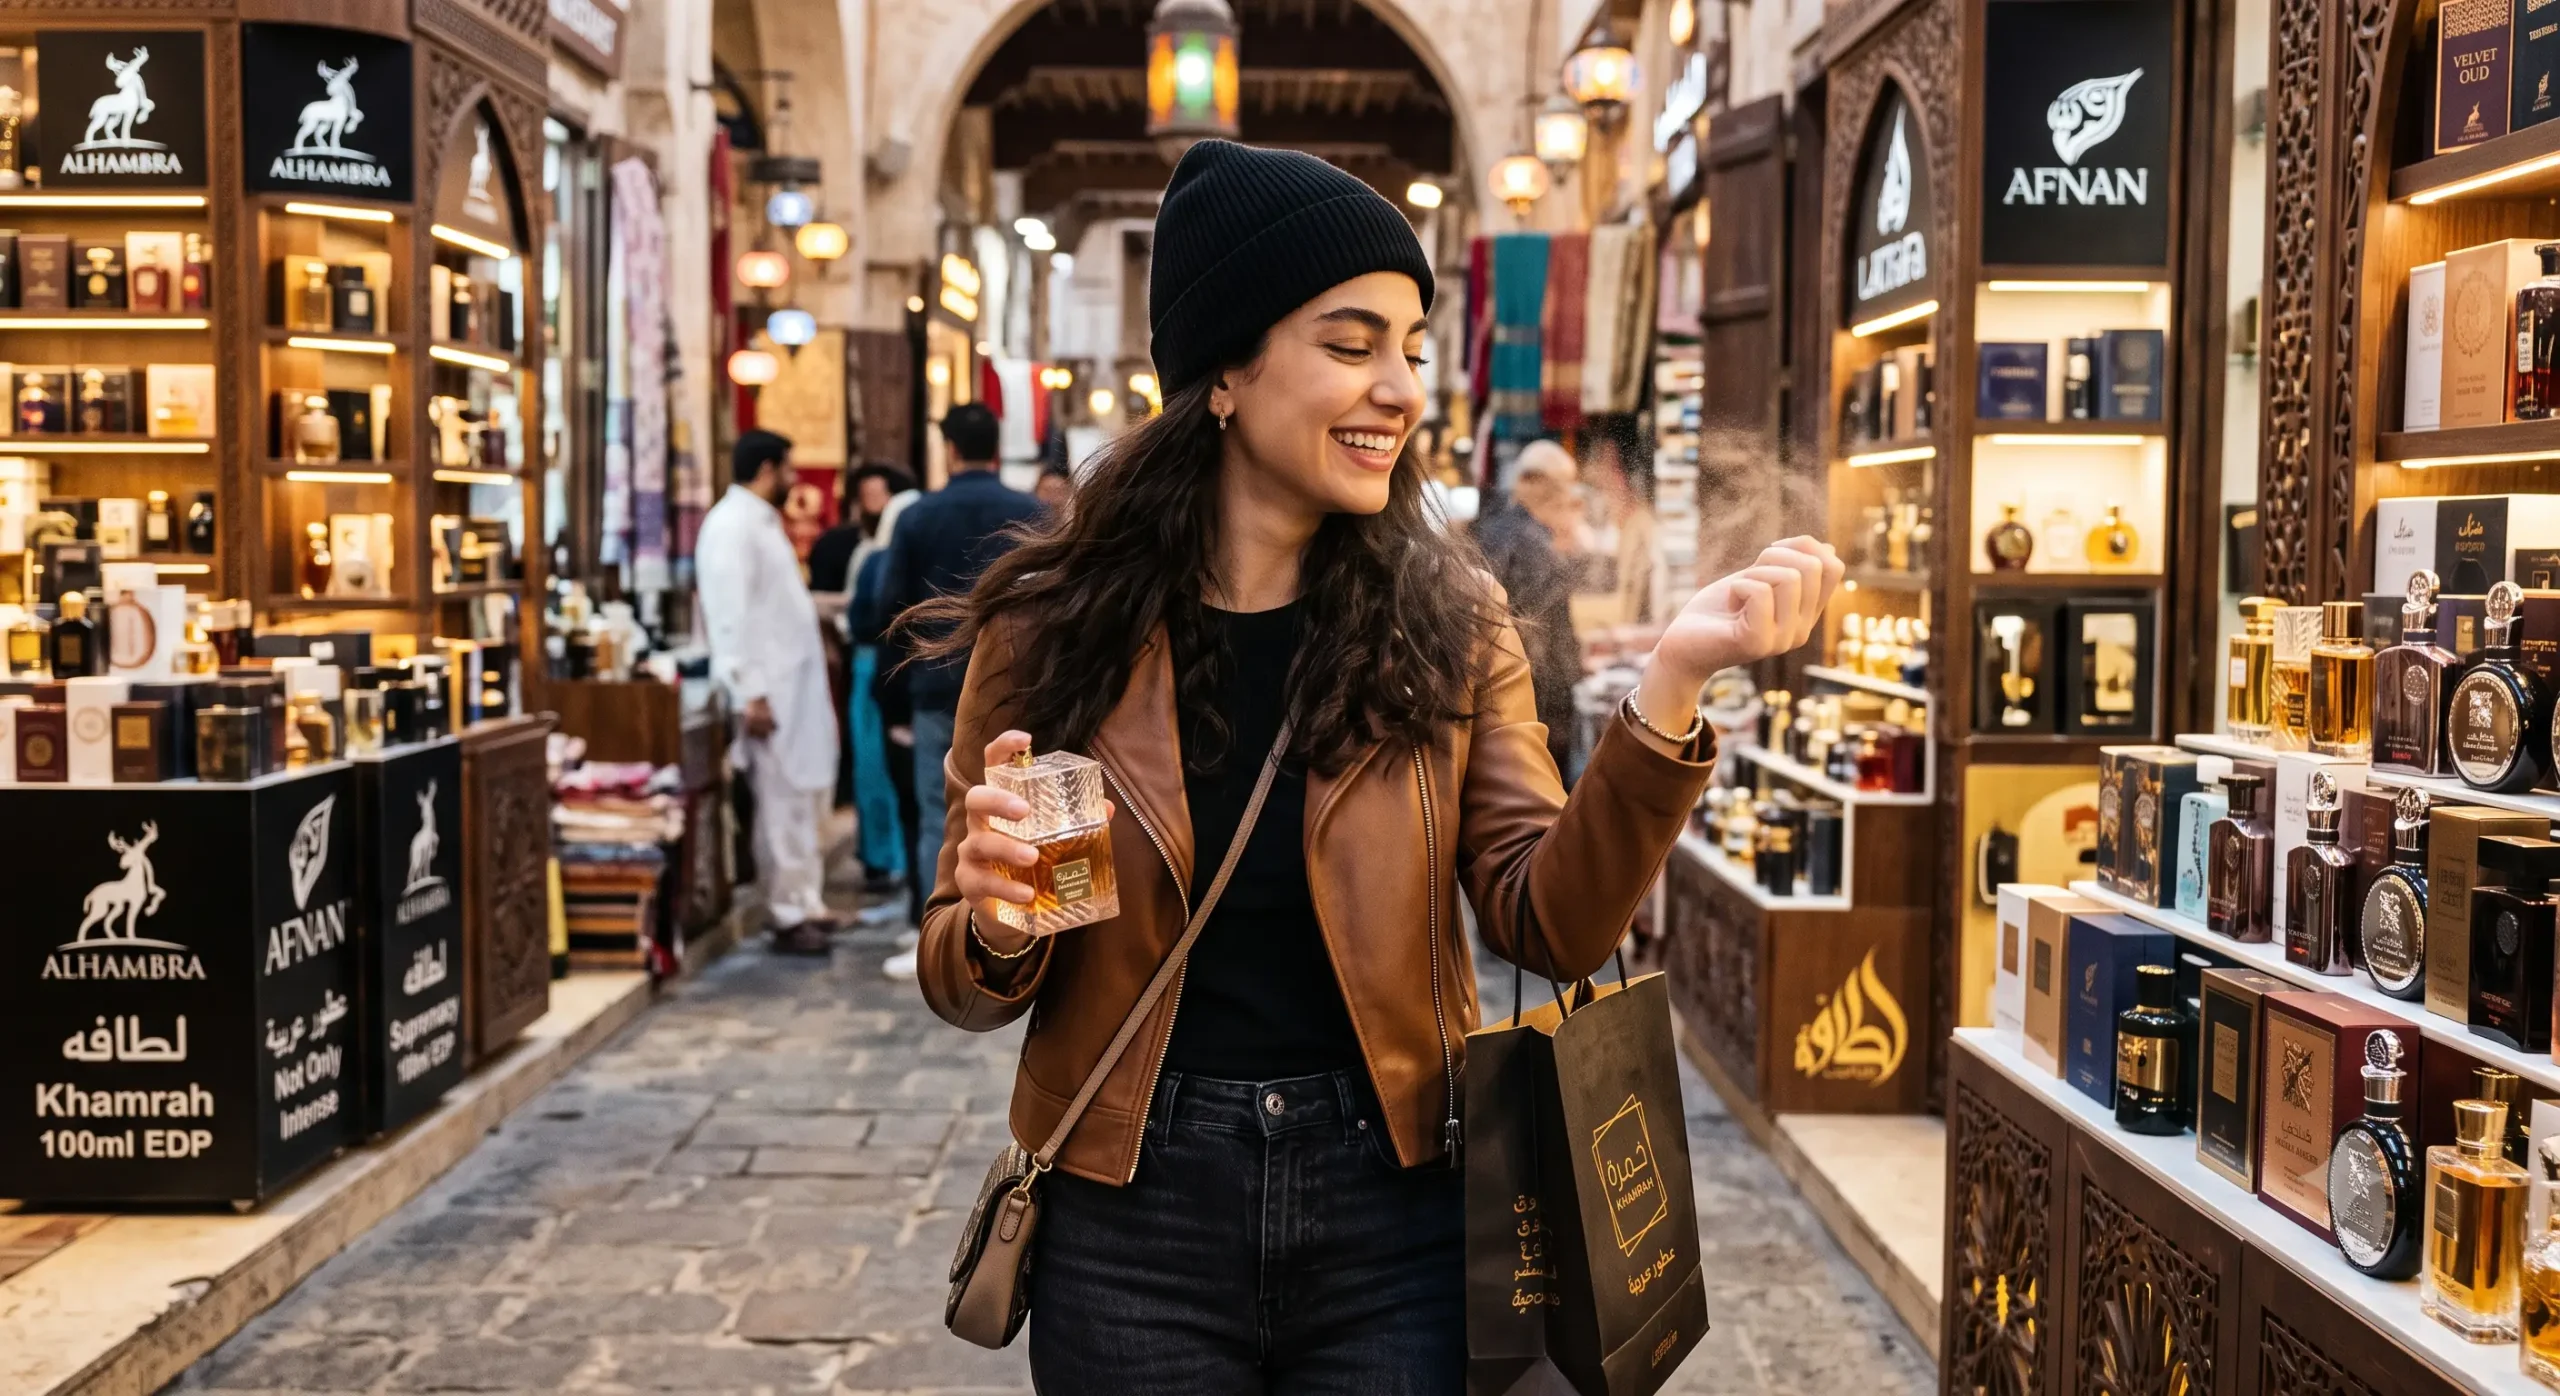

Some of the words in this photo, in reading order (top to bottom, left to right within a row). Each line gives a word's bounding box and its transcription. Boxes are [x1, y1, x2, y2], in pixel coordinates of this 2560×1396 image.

[2453, 47, 2498, 68] VELVET
[2459, 65, 2490, 84] OUD
[60, 152, 183, 175] ALHAMBRA
[269, 156, 392, 188] ALHAMBRA
[2003, 167, 2148, 205] AFNAN
[265, 902, 345, 976] AFNAN
[42, 953, 207, 980] ALHAMBRA
[62, 1015, 187, 1062] لطافه
[274, 1060, 304, 1102] Not
[306, 1043, 342, 1084] Only
[37, 1083, 213, 1118] Khamrah
[280, 1089, 340, 1141] Intense
[40, 1129, 134, 1158] 100ml
[144, 1129, 213, 1158] EDP
[1606, 1141, 1648, 1192] خمرة
